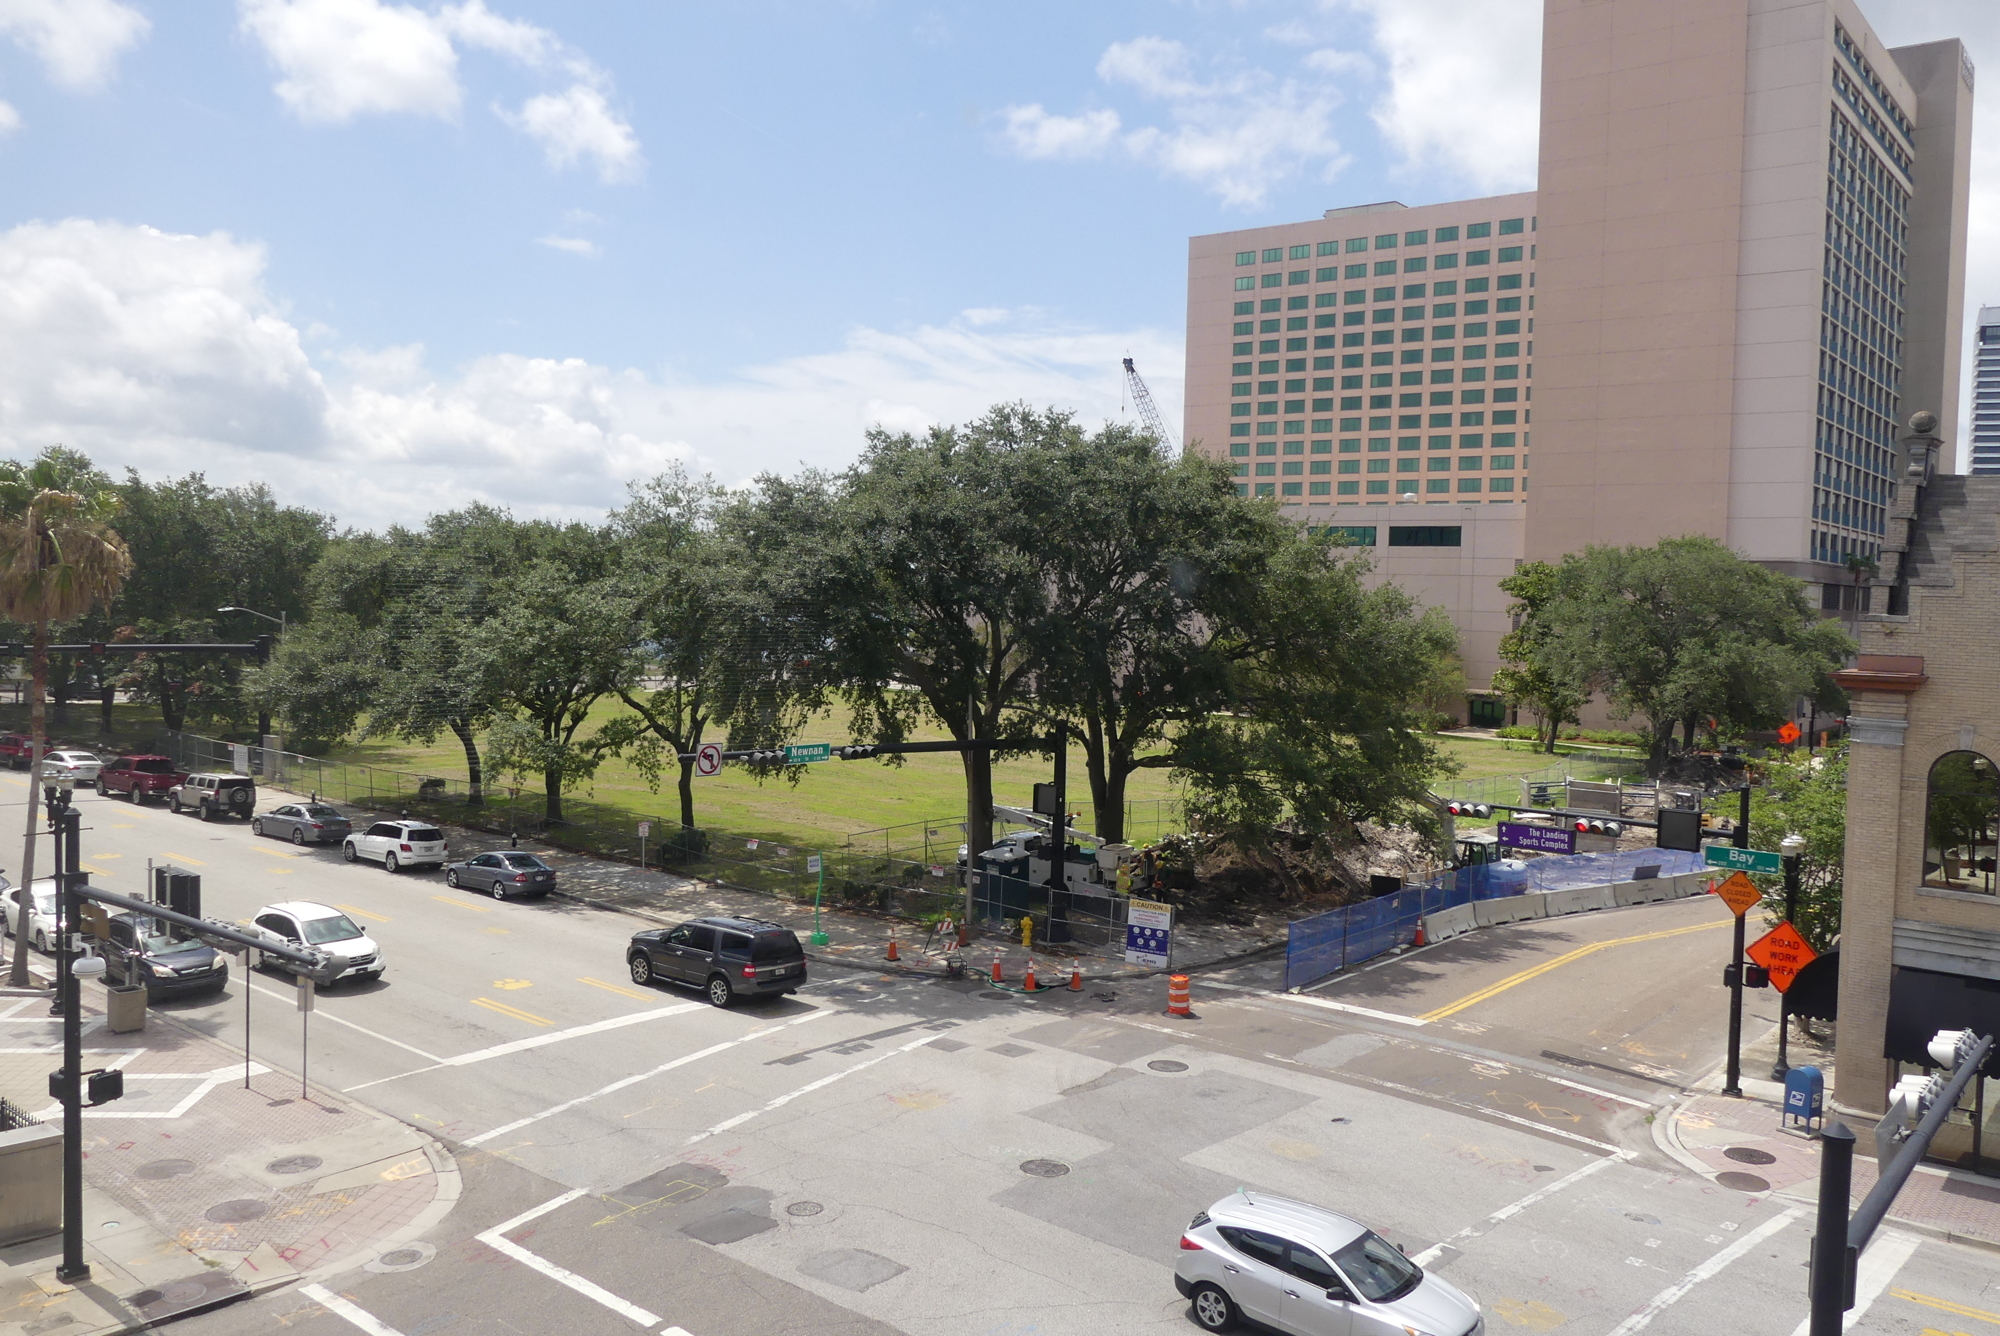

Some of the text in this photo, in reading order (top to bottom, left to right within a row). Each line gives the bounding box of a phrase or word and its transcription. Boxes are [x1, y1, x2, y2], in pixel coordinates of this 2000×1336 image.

[791, 747, 824, 757] Newnan
[1529, 828, 1568, 842] The Landing
[1519, 836, 1568, 850] Sports Complex
[1729, 850, 1755, 865] Bay
[1730, 880, 1749, 889] ROAD
[1726, 888, 1752, 898] CLOSED
[1136, 902, 1164, 911] CAUTION
[1728, 897, 1750, 906] AHEAD
[1770, 937, 1800, 951] ROAD
[1769, 951, 1799, 964] WORK
